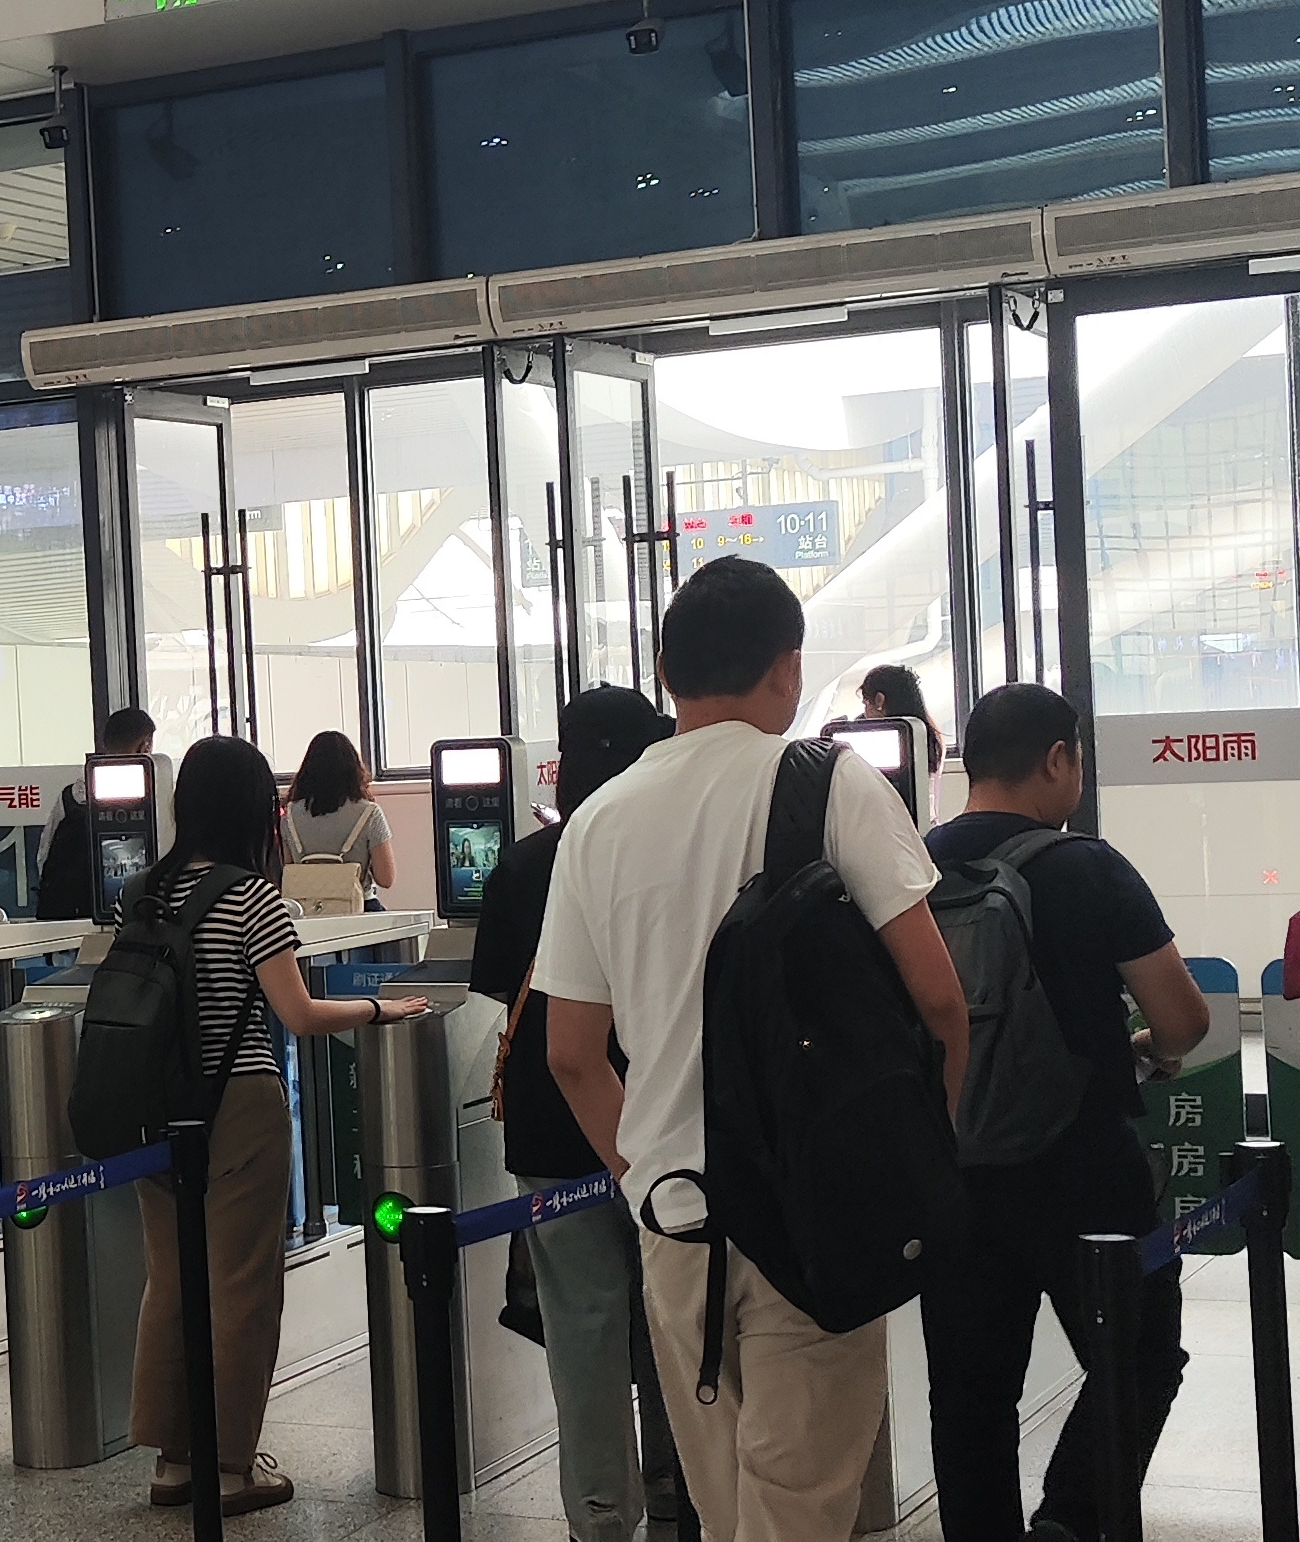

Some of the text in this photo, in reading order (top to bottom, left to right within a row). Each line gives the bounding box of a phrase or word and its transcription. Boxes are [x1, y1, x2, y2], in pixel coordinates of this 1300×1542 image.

[798, 534, 827, 550] 站台
[1151, 732, 1257, 764] 太阳雨
[537, 761, 562, 786] 太阳
[1168, 1092, 1203, 1127] 房
[1170, 1142, 1206, 1177] 房
